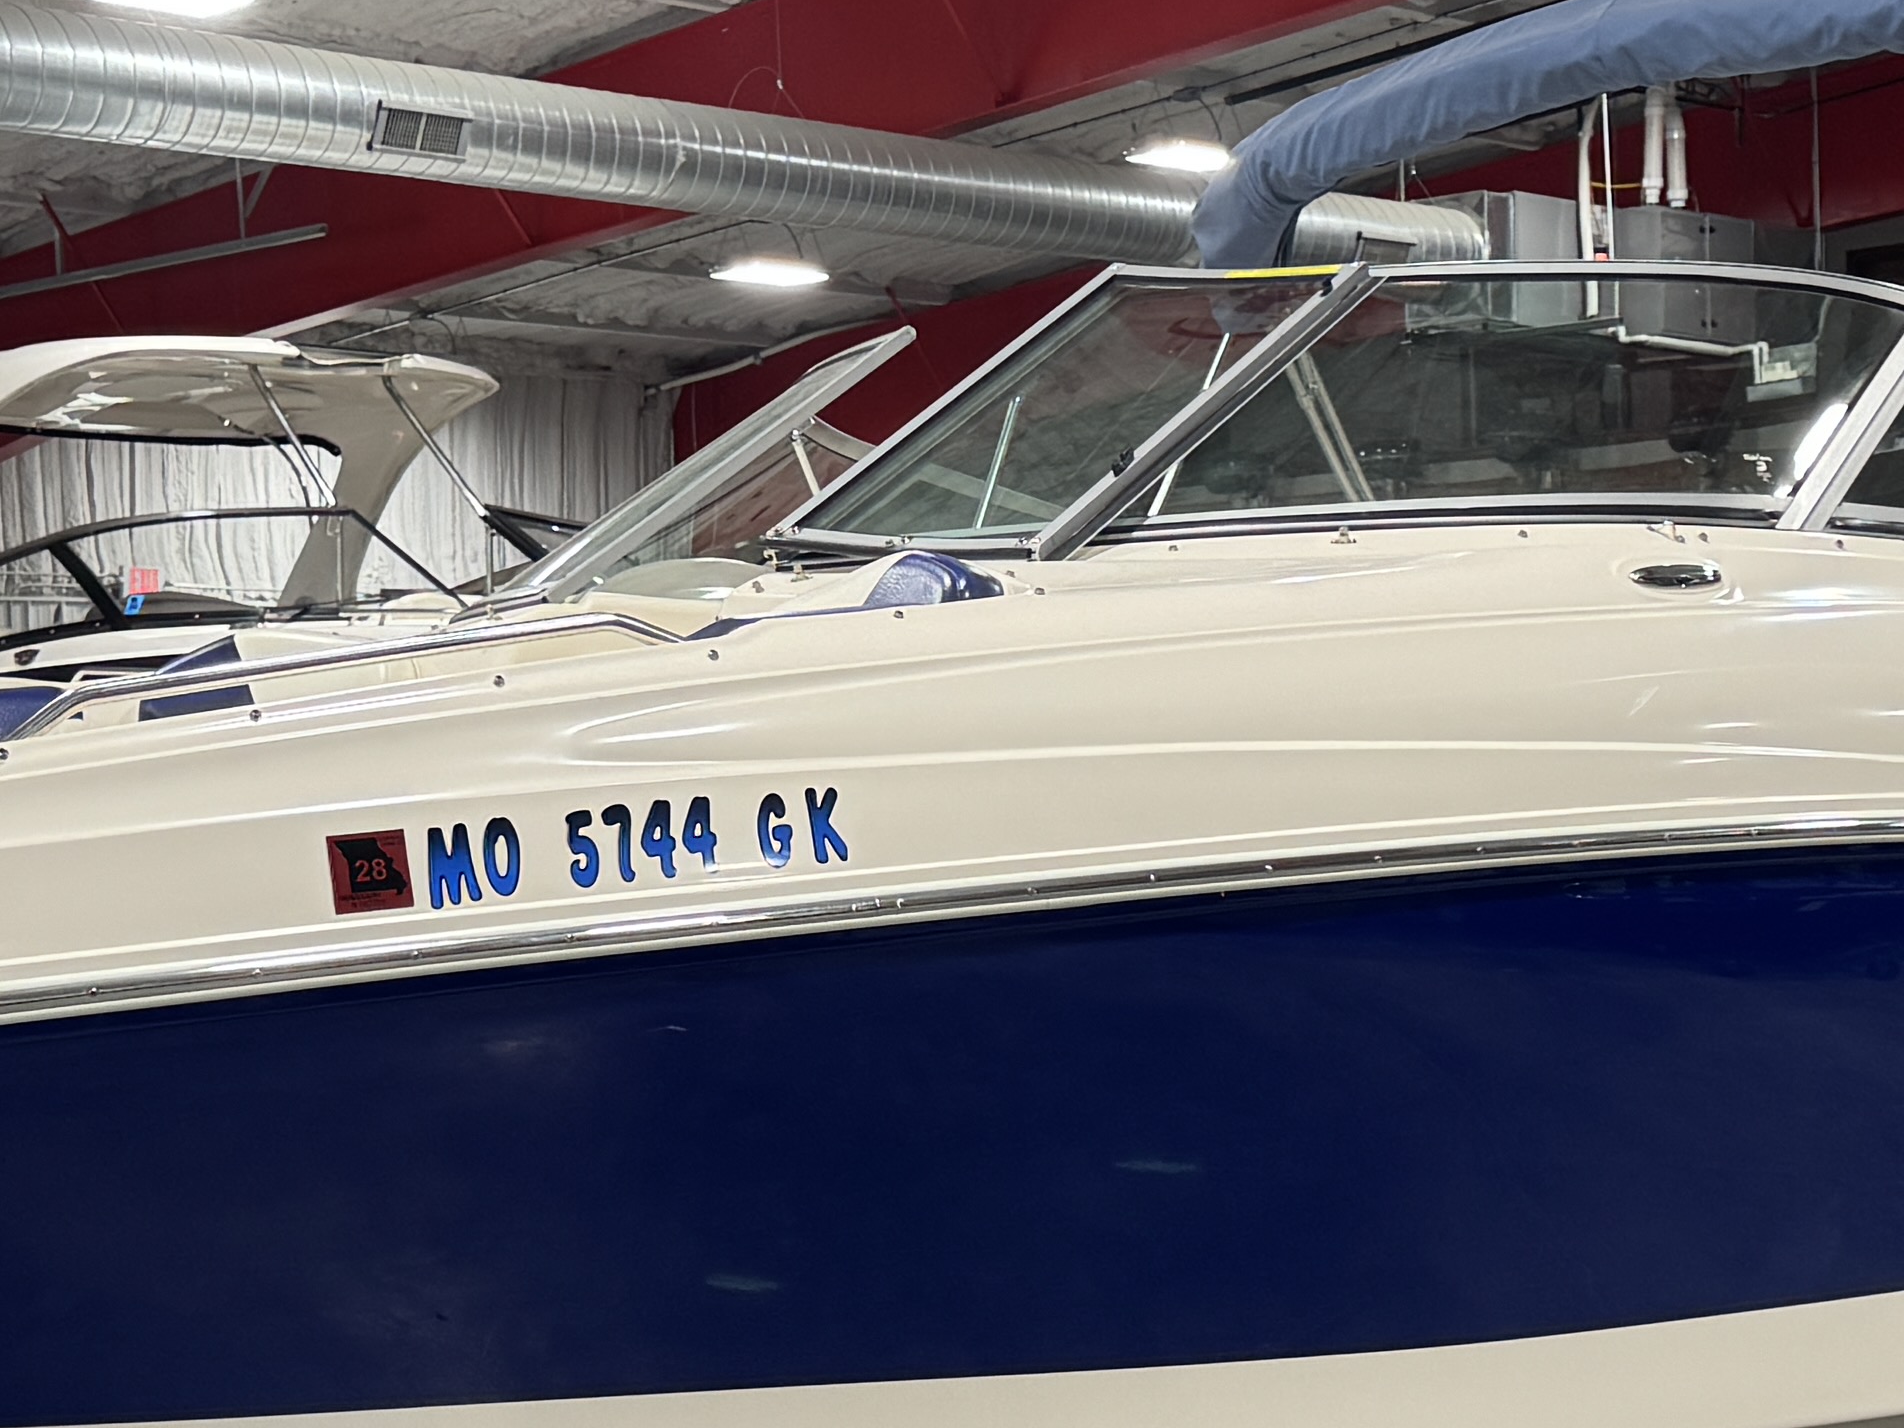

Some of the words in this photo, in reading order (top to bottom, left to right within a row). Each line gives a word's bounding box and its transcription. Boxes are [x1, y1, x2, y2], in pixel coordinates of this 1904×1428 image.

[355, 858, 387, 882] 28
[427, 817, 520, 910] MO
[566, 796, 717, 888] 5744
